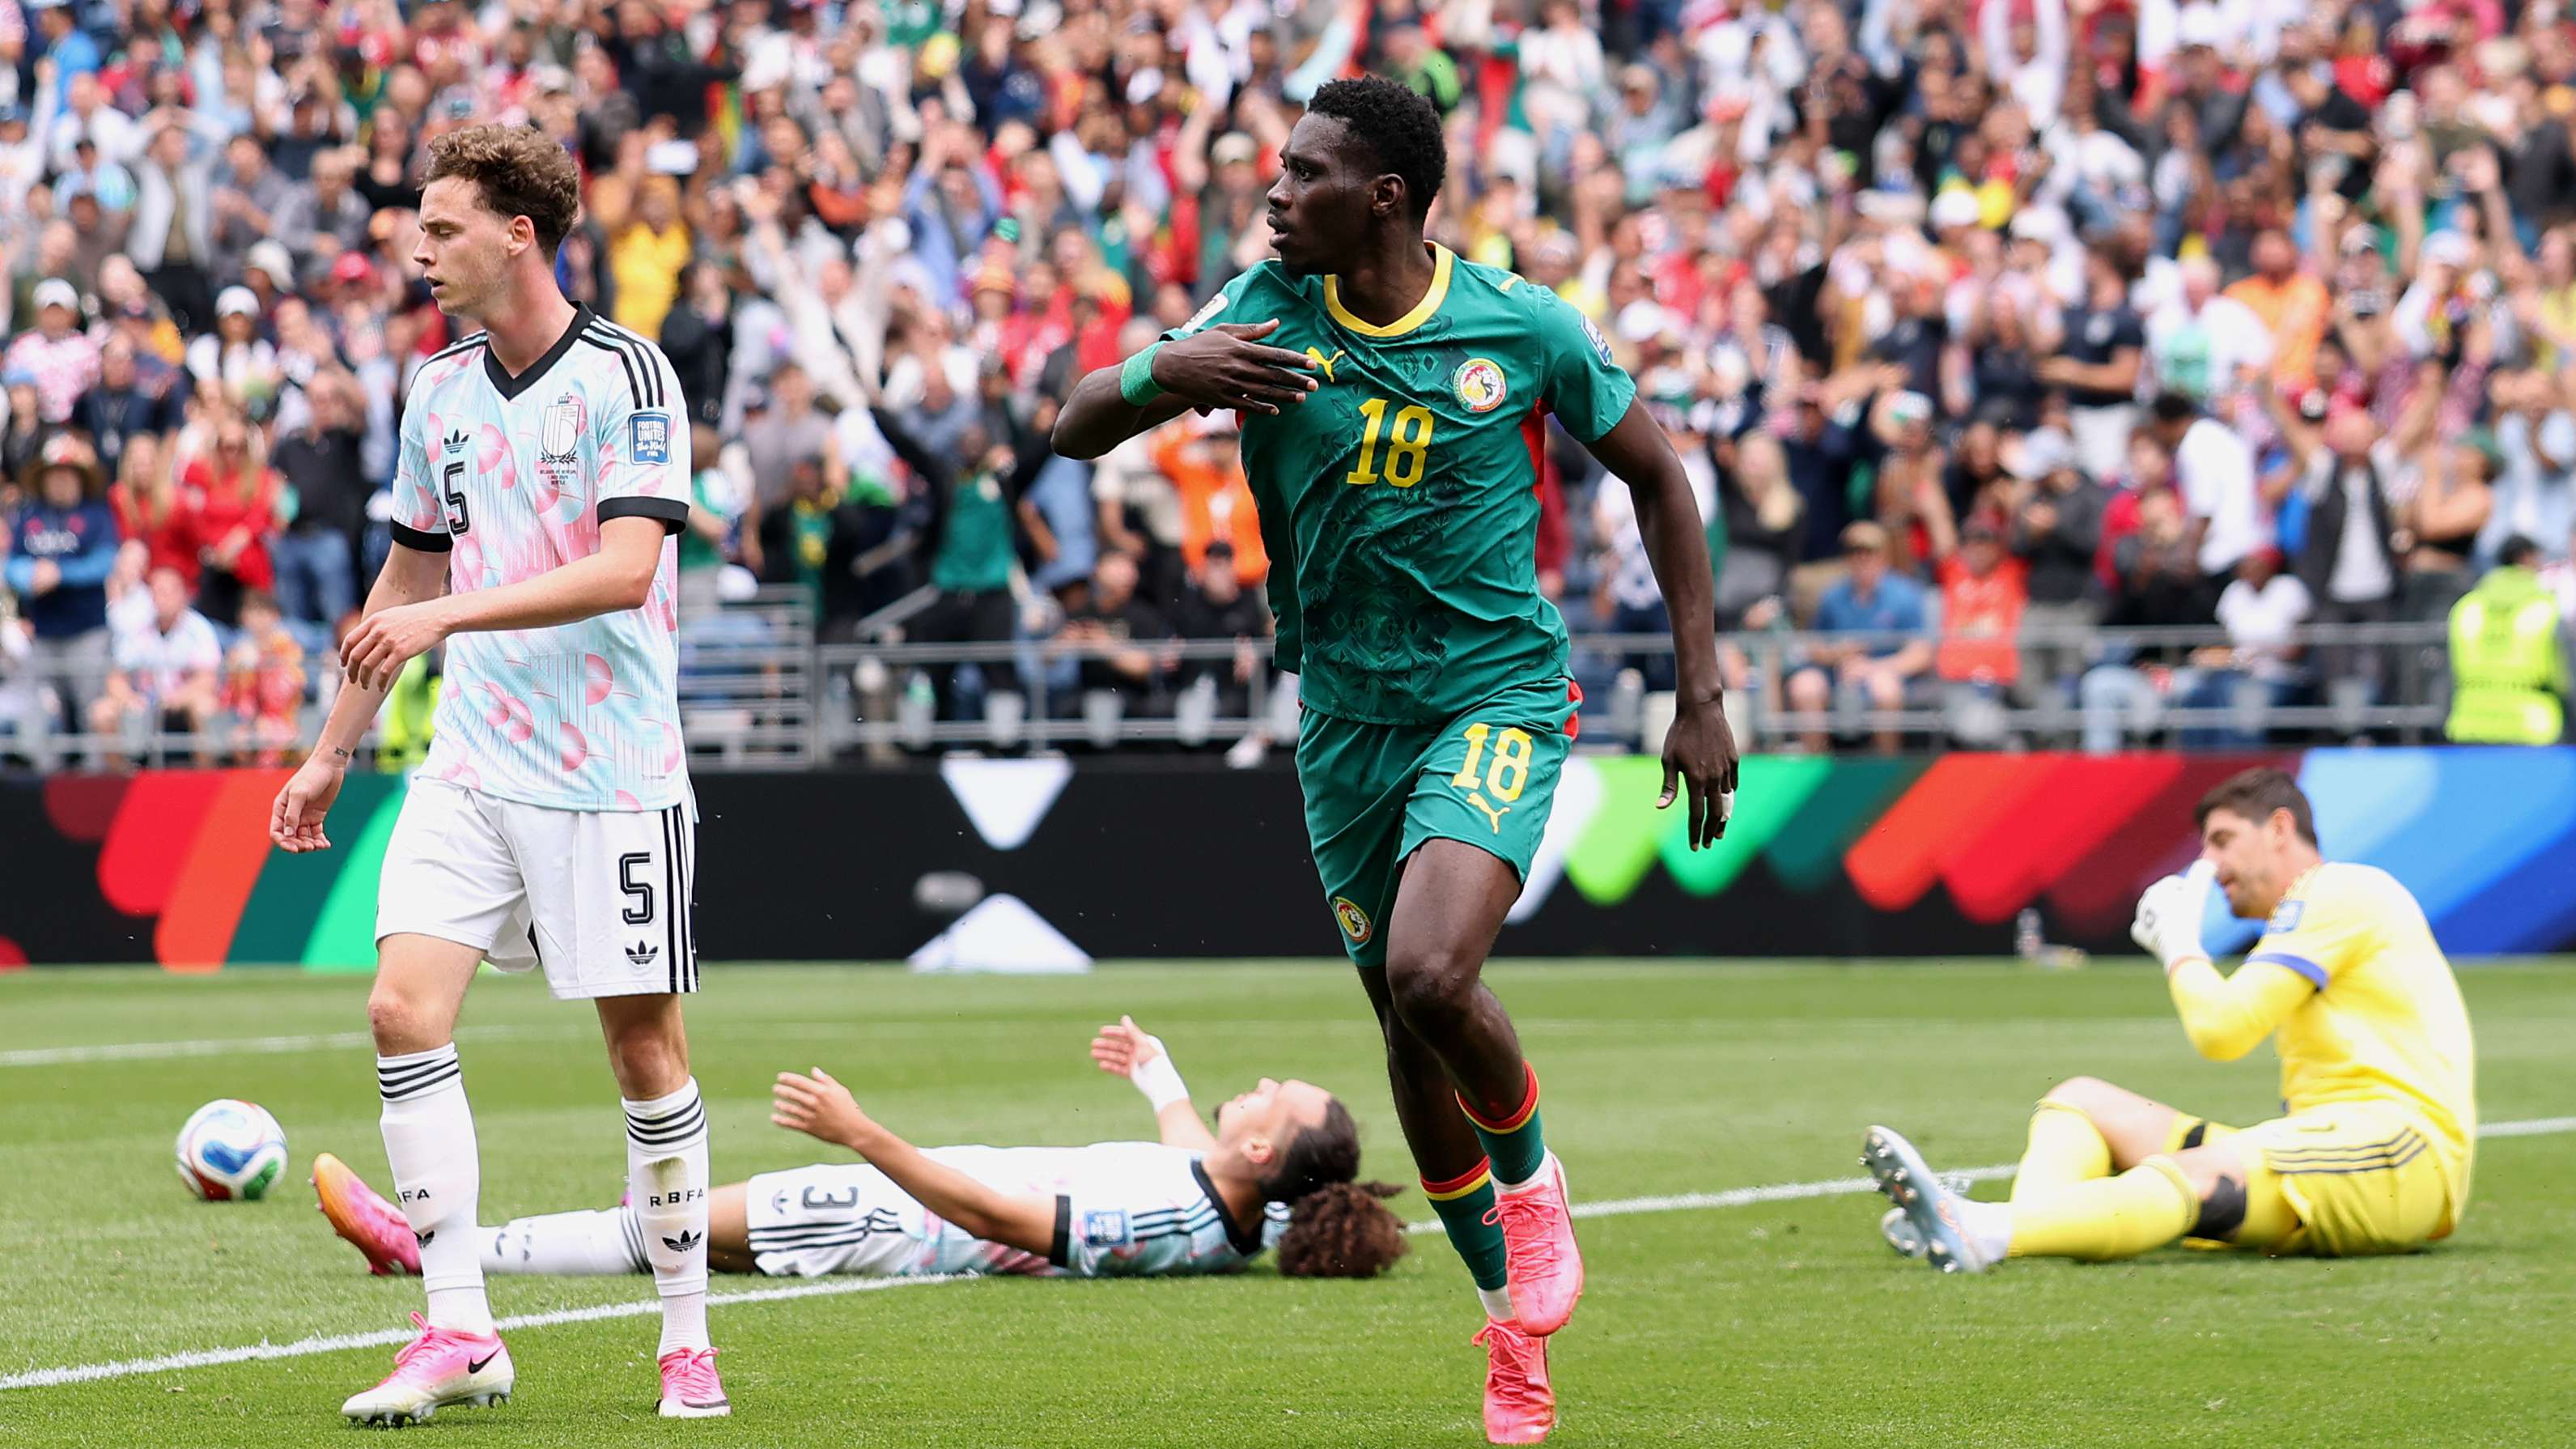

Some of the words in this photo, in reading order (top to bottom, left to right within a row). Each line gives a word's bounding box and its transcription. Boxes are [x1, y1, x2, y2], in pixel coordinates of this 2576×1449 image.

[1346, 397, 1434, 488] 18
[444, 461, 470, 538] 5
[1450, 722, 1533, 803] 18
[618, 852, 656, 927] 5
[649, 1188, 703, 1207] RBFA
[803, 1186, 859, 1209] 3
